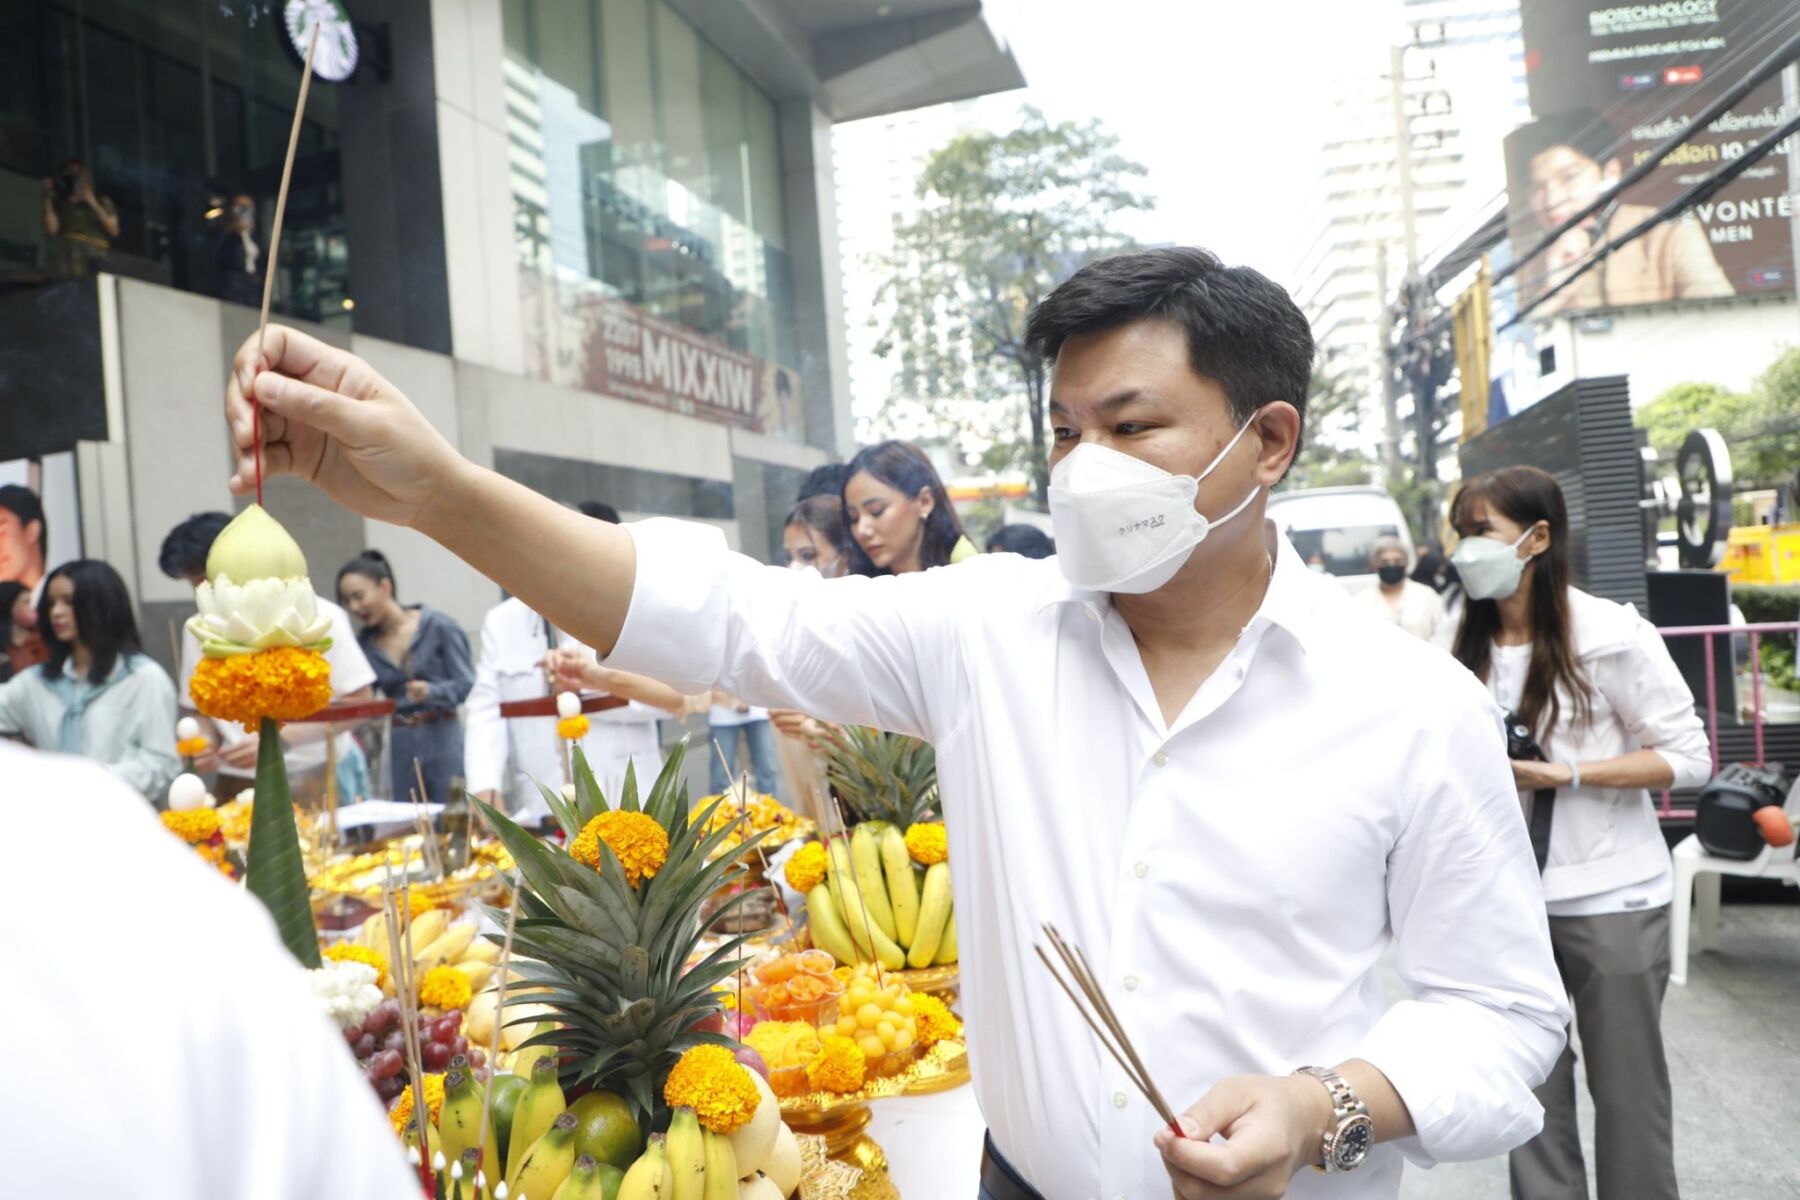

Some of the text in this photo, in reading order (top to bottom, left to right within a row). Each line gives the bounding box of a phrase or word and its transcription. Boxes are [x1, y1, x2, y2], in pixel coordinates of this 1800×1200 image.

[1589, 0, 1718, 27] BIOTECHNOLOGY
[1710, 225, 1753, 243] MEN
[642, 327, 754, 416] MIXXIW
